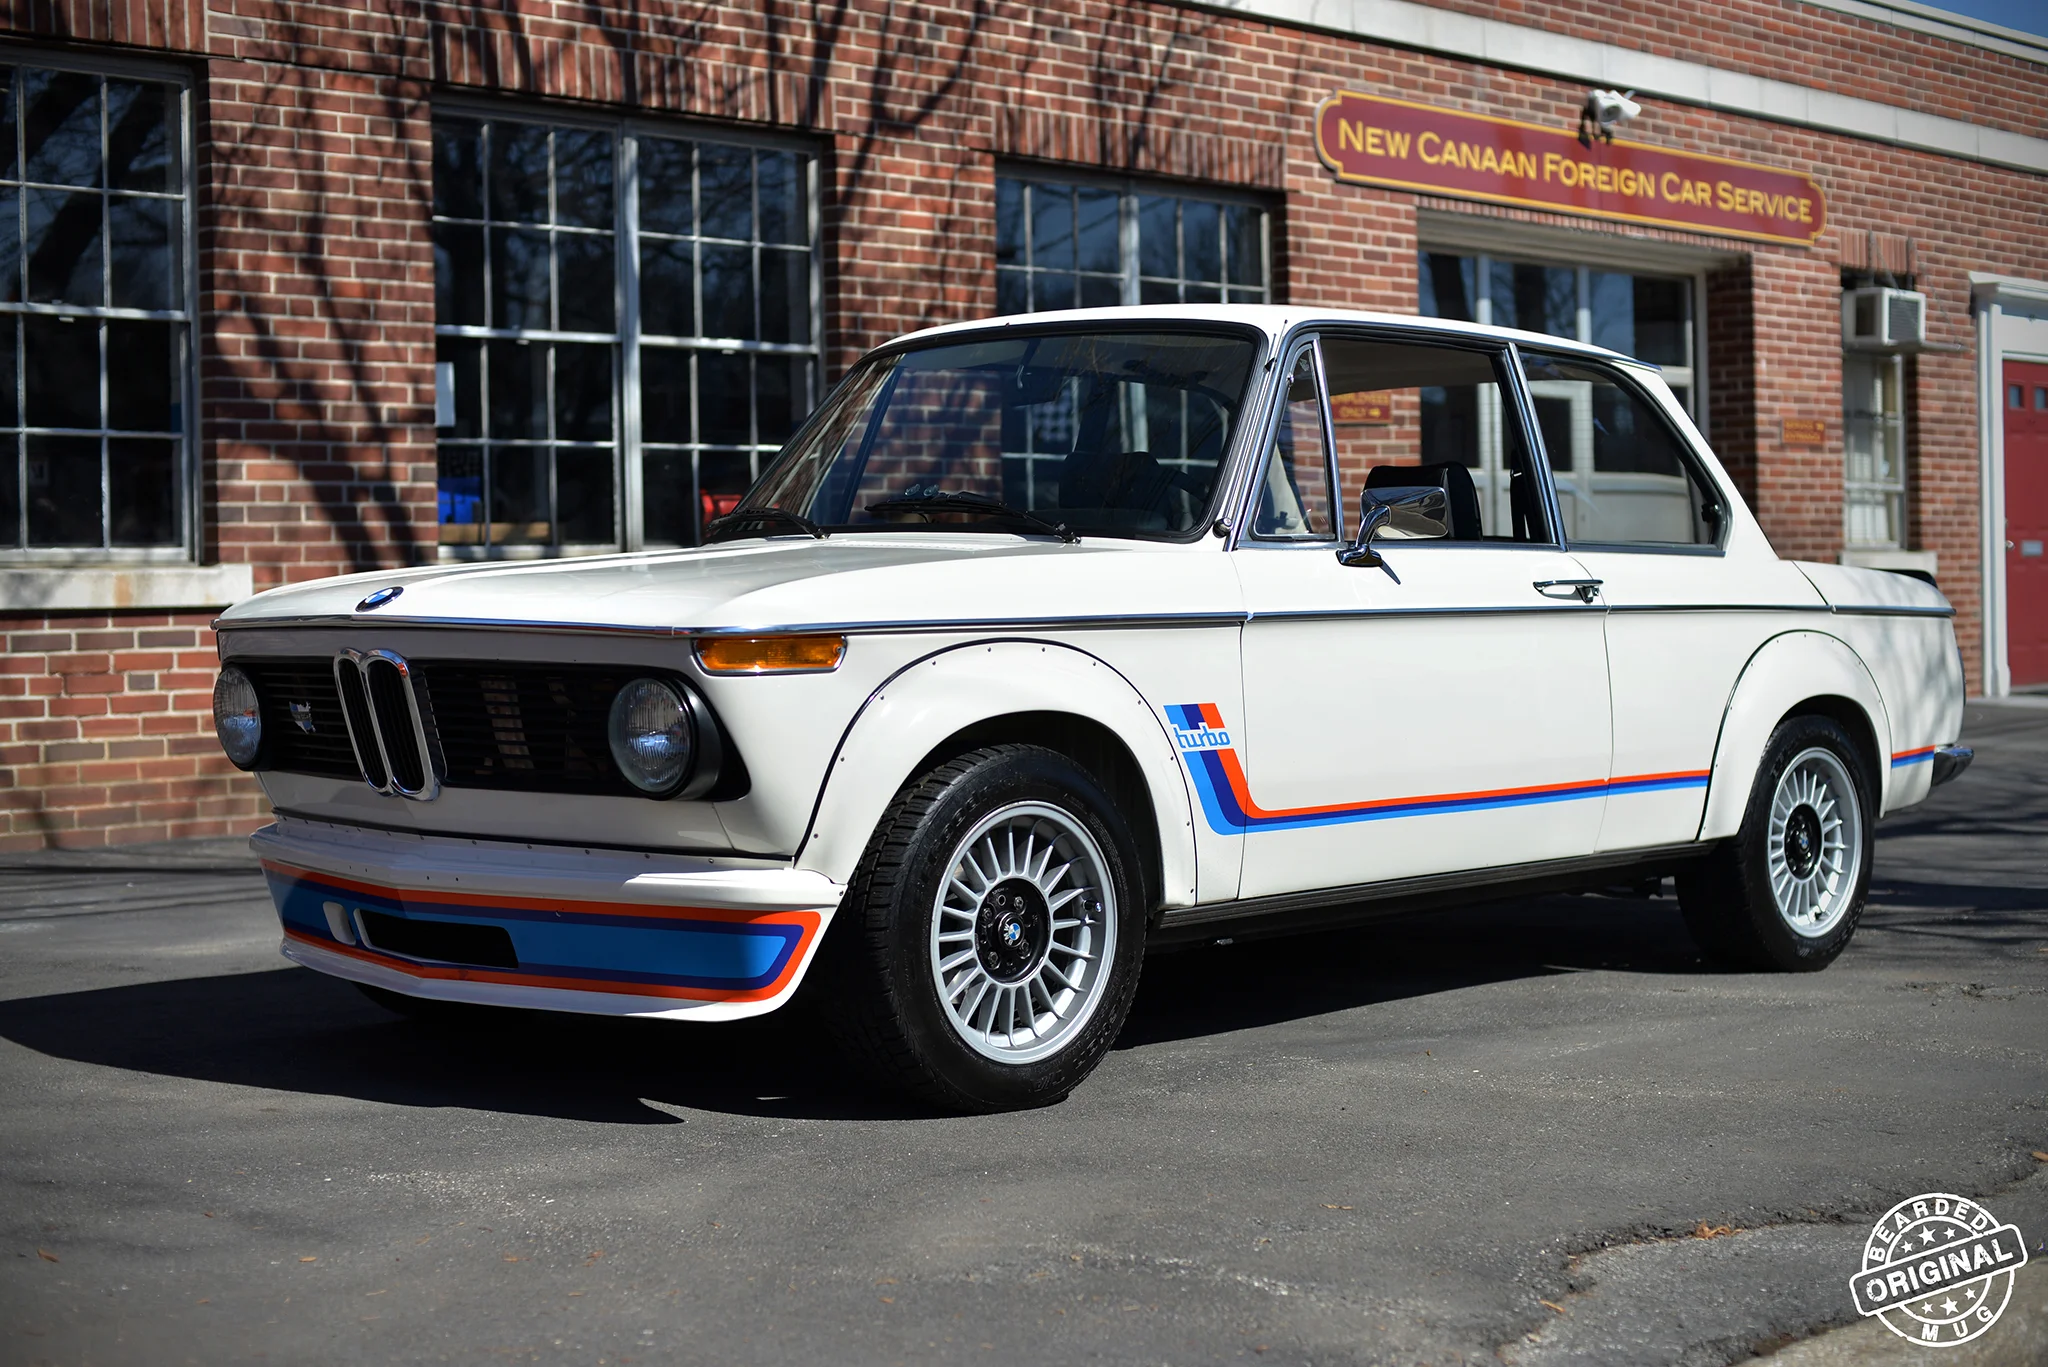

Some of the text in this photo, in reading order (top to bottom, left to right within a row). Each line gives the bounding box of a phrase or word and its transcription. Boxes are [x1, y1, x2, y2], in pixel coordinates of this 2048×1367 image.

[1338, 117, 1813, 224] NEW CANAAN FOREIGN CAR SERVICE
[1173, 725, 1231, 749] turbo
